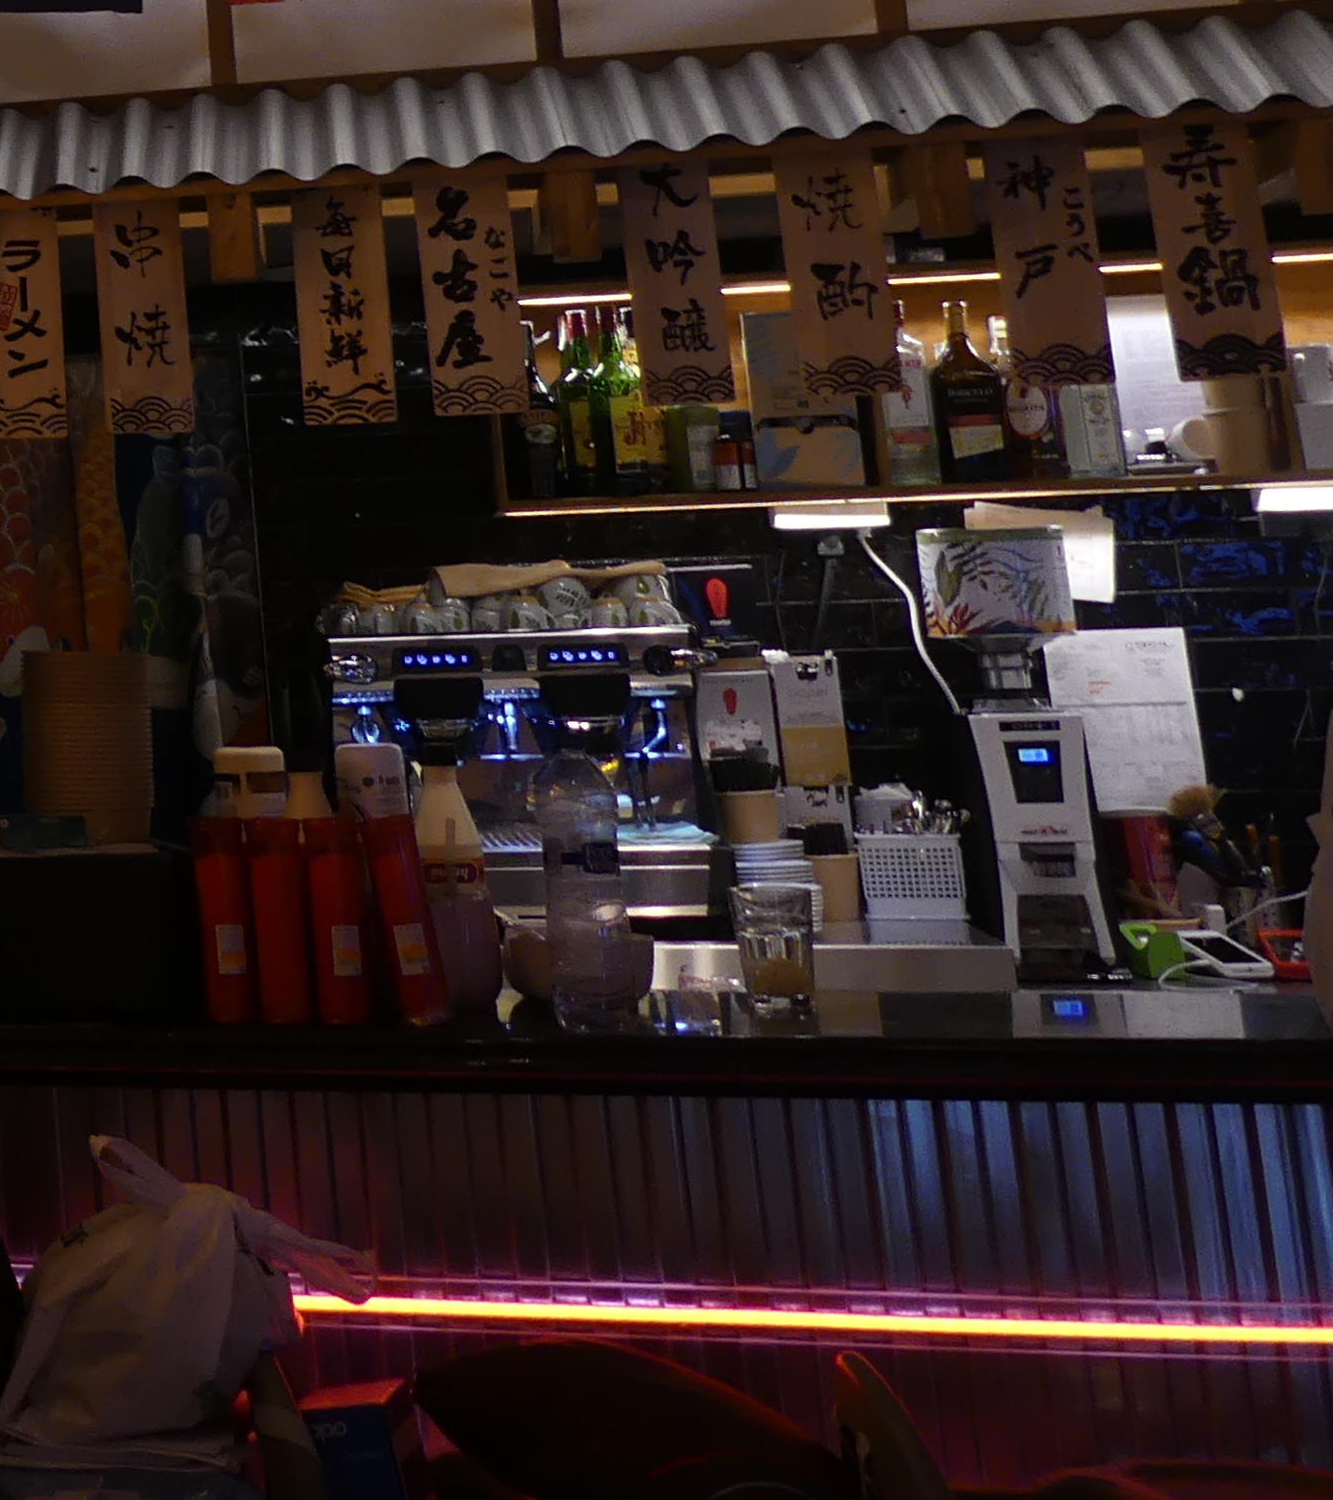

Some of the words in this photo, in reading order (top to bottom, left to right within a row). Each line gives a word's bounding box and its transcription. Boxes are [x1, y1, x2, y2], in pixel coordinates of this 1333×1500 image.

[427, 186, 494, 369] 名古屋
[995, 155, 1059, 299] 神戸
[2, 240, 49, 378] ラーメン
